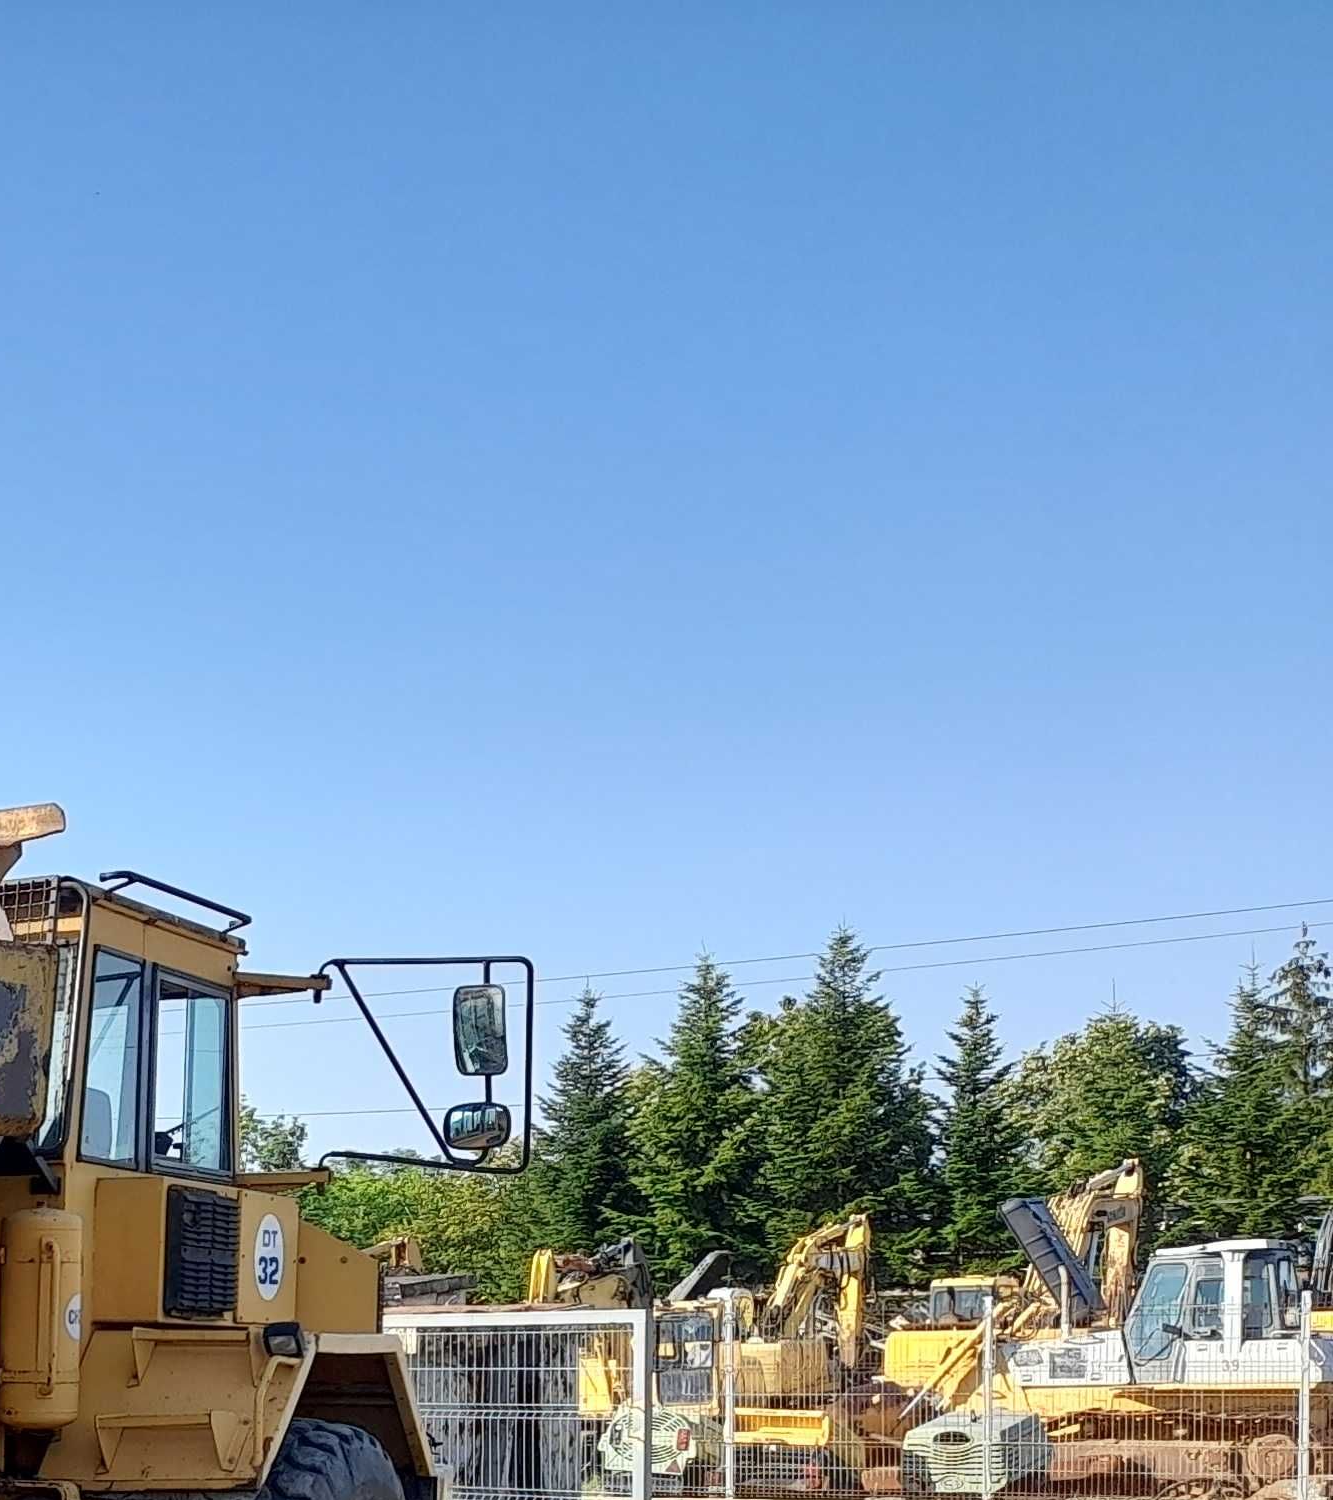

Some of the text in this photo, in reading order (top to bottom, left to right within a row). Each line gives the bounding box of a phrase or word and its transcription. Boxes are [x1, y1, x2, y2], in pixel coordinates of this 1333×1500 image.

[262, 1229, 278, 1248] DT
[258, 1256, 279, 1285] 32
[1222, 1359, 1239, 1372] 39
